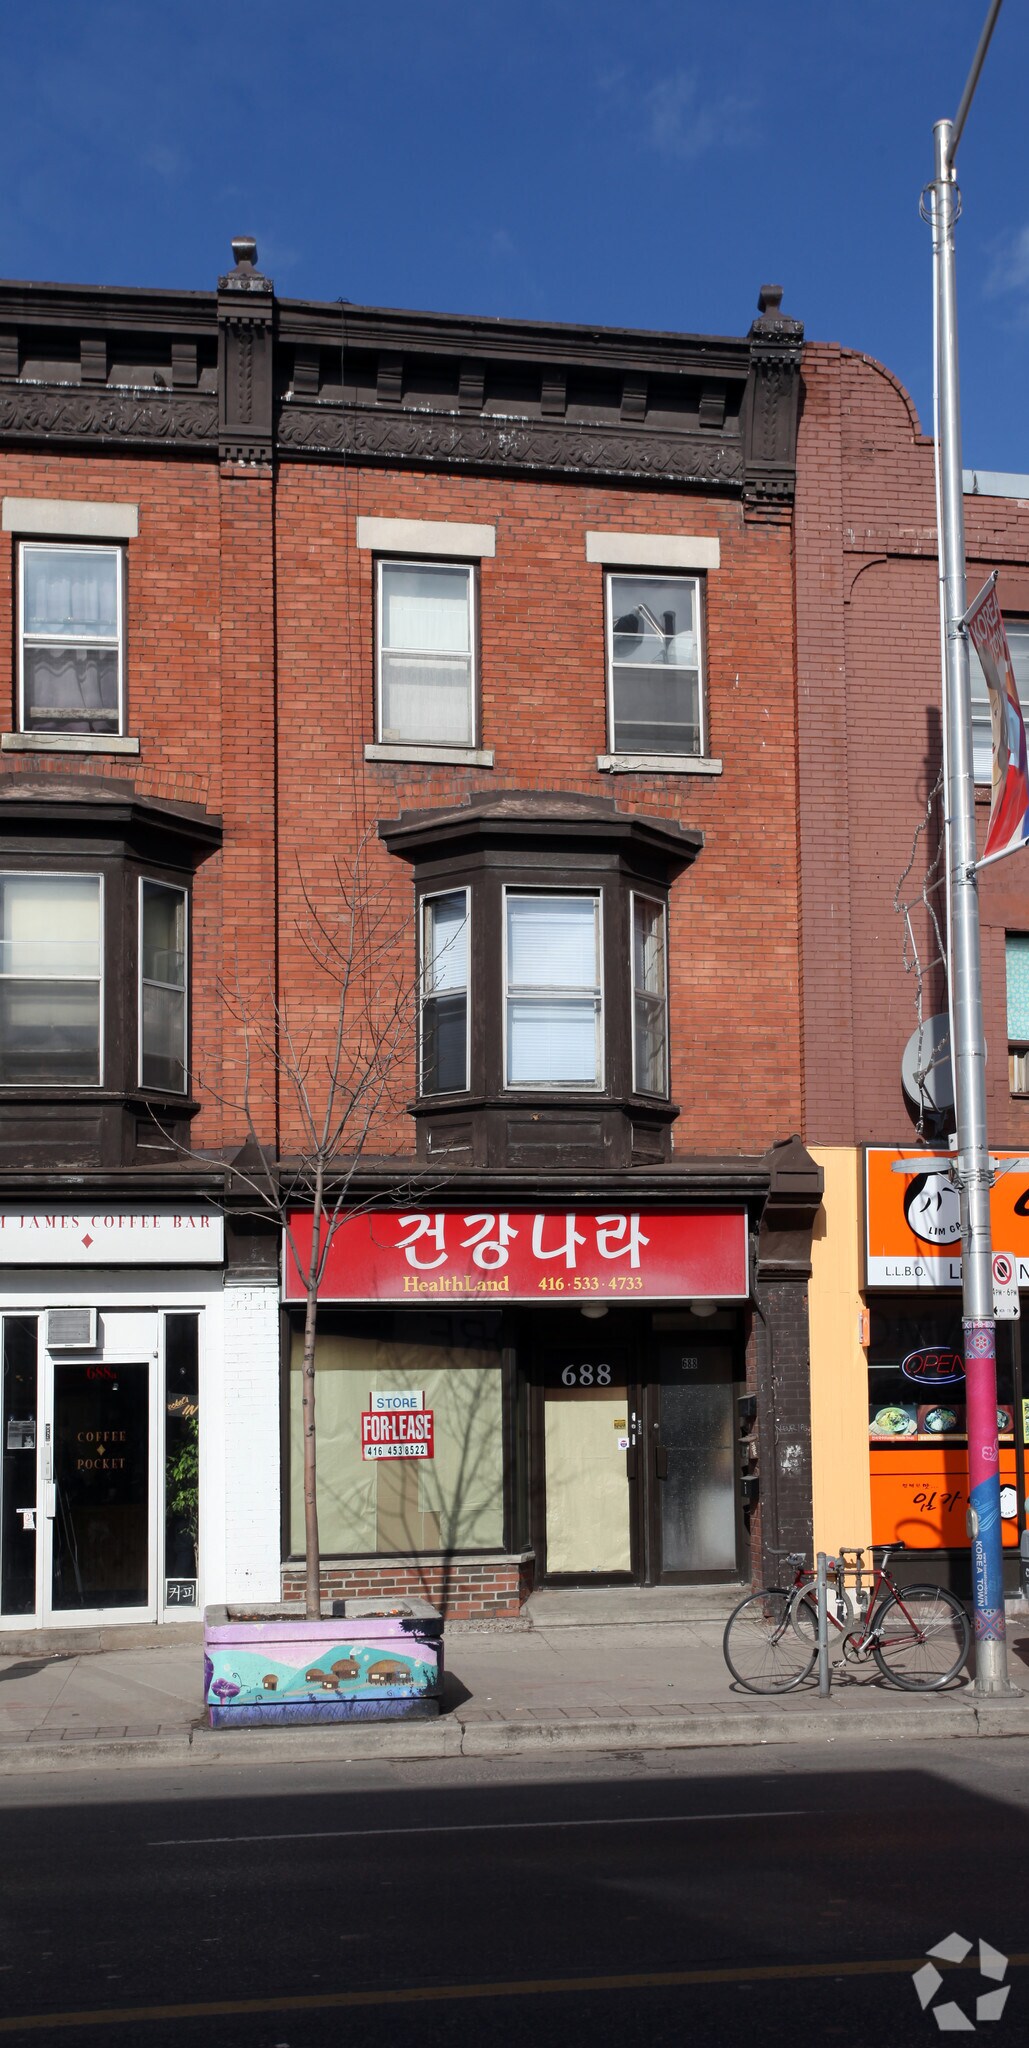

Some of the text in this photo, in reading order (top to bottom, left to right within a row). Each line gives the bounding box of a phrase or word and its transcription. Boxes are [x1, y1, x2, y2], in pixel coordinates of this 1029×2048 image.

[19, 1215, 79, 1228] JAMES
[91, 1215, 161, 1228] COFFEE
[173, 1215, 210, 1228] BAR
[929, 1227, 946, 1236] LIM
[394, 1213, 650, 1270] 건강나라
[885, 1266, 926, 1277] L.L.B.O.
[403, 1275, 510, 1293] HealthLand
[682, 1358, 697, 1369] 688
[906, 1354, 965, 1373] OPEN
[561, 1363, 612, 1386] 688
[376, 1397, 418, 1408] STORE
[77, 1431, 126, 1442] COFFEE
[367, 1446, 383, 1456] 416
[77, 1458, 126, 1470] POCKET
[169, 1584, 195, 1602] 커피
